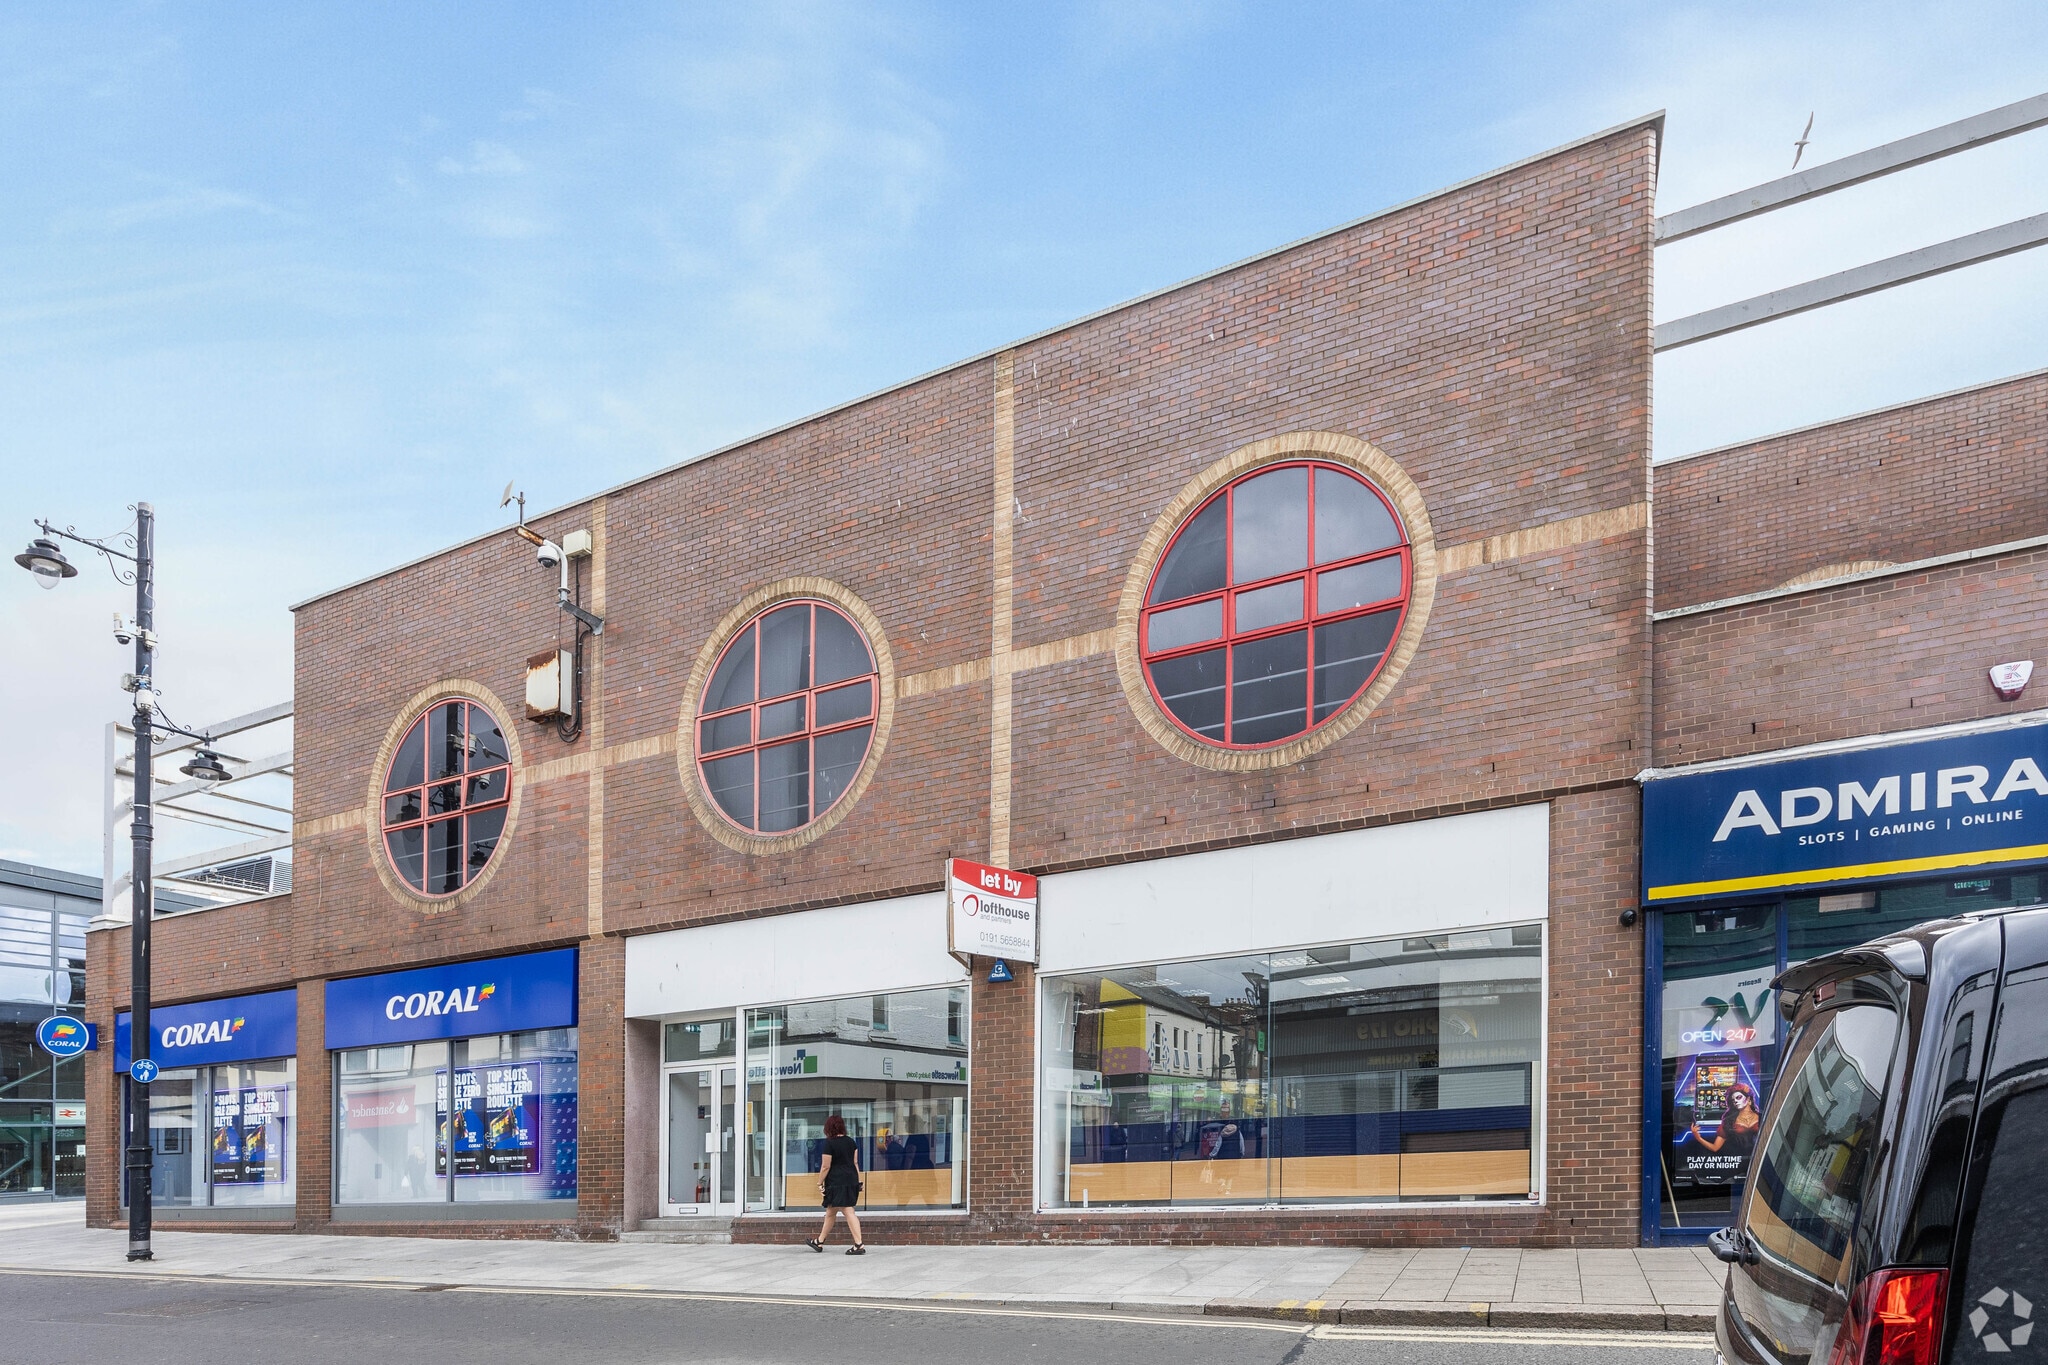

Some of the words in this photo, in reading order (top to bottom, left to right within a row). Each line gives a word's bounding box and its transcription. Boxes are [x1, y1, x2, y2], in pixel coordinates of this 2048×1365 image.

[1798, 830, 1845, 846] SLOTS
[1869, 819, 1936, 838] GAMING
[1961, 808, 2024, 826] ONLINE
[980, 869, 1000, 889] let
[1004, 874, 1022, 896] by
[980, 900, 1030, 920] lofthouse
[991, 915, 1012, 924] partners
[979, 931, 998, 943] 0191
[385, 985, 479, 1021] CORAL
[161, 1019, 233, 1048] CORAL
[1681, 1030, 1722, 1043] OPEN
[1726, 1028, 1757, 1041] 24/7
[47, 1040, 81, 1048] CORAL
[437, 1075, 447, 1087] TO
[487, 1070, 502, 1083] TOP
[503, 1068, 529, 1082] SLOTS,
[463, 1084, 481, 1097] ZERO
[487, 1082, 513, 1095] SINGLE
[513, 1080, 533, 1093] ZERO
[244, 1092, 256, 1104] TOP
[437, 1098, 472, 1112] ROETTE
[486, 1094, 523, 1108] ROULETTE
[225, 1105, 241, 1116] ZERO
[243, 1103, 264, 1115] SINGLE
[264, 1101, 280, 1114] ZERO
[243, 1113, 272, 1126] ROULETTE
[1722, 1155, 1742, 1163] TIME
